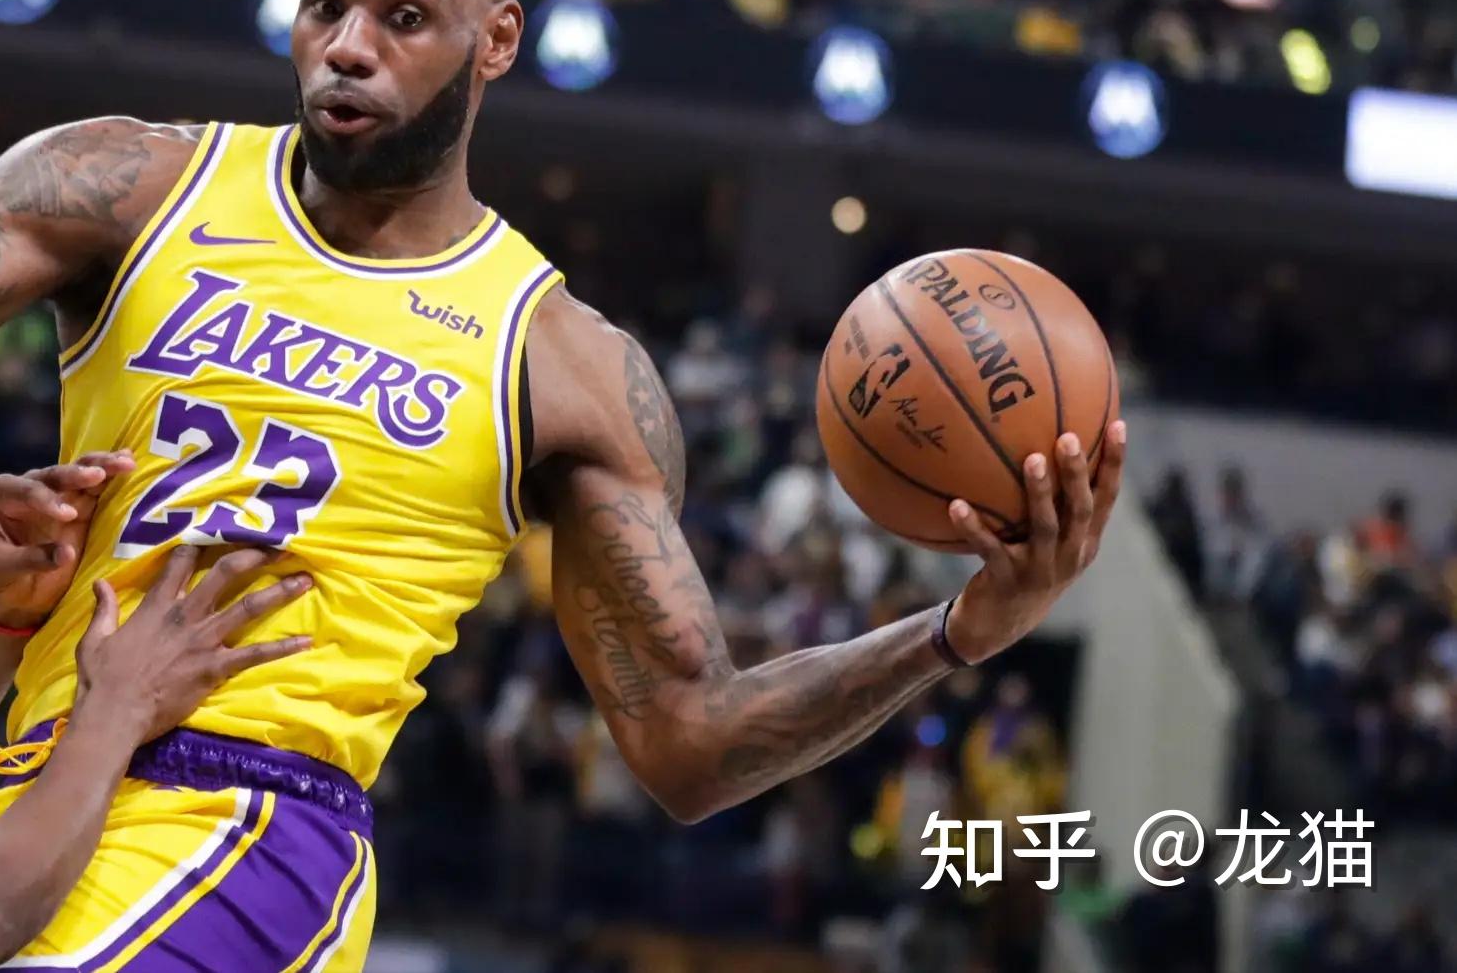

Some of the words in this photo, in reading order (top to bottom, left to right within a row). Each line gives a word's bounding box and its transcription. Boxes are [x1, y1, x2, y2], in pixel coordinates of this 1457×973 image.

[126, 268, 464, 450] LAKERS
[407, 289, 485, 340] wish
[114, 390, 341, 558] 23
